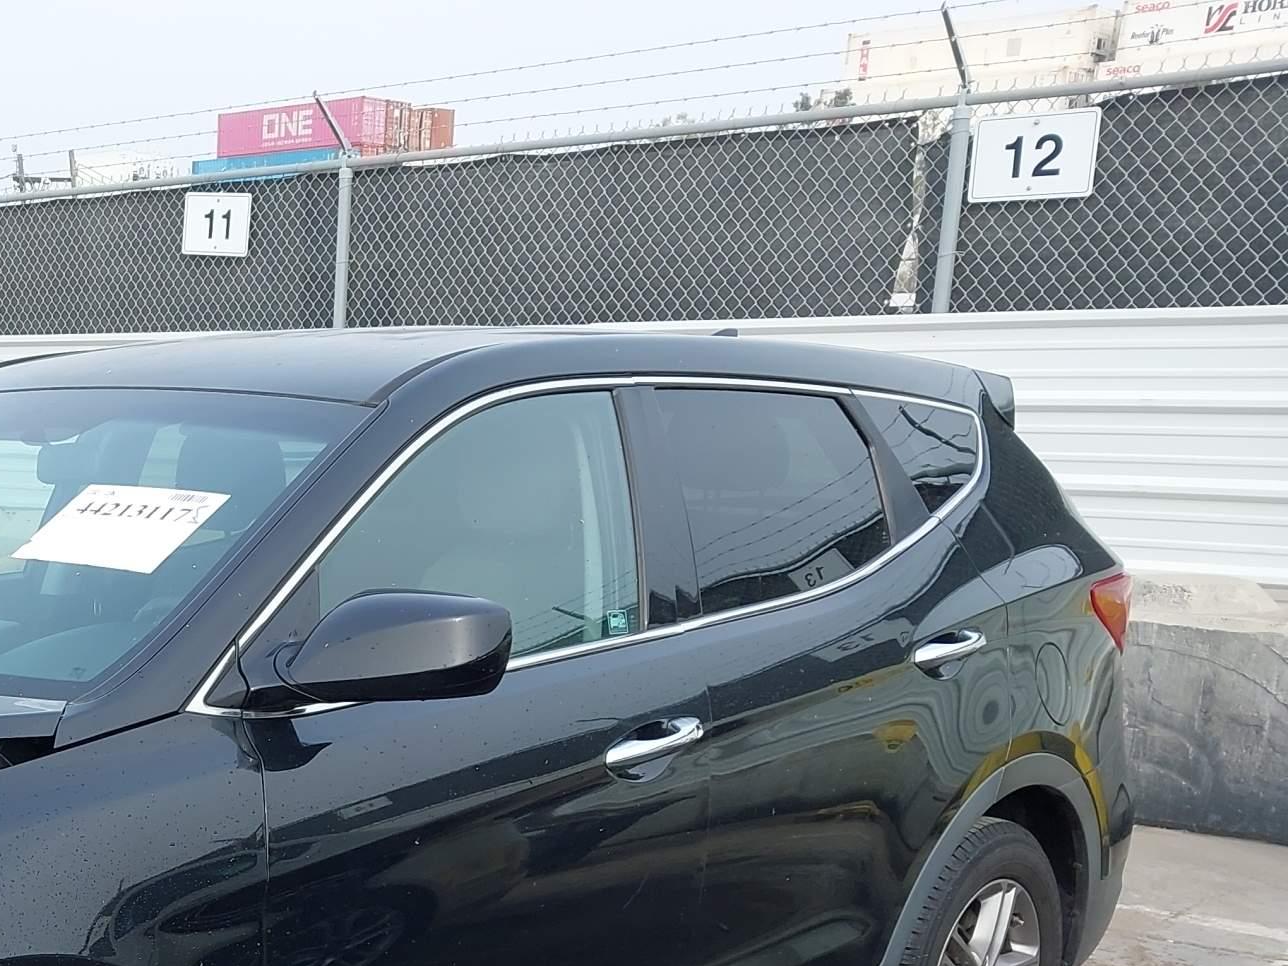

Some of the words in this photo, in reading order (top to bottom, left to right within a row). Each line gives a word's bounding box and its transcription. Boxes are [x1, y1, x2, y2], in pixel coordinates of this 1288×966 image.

[1135, 1, 1171, 13] seaco
[1105, 64, 1141, 76] seaco
[262, 109, 313, 139] ONE
[1004, 133, 1064, 178] 12
[204, 208, 232, 240] 11
[76, 501, 193, 522] 44213117
